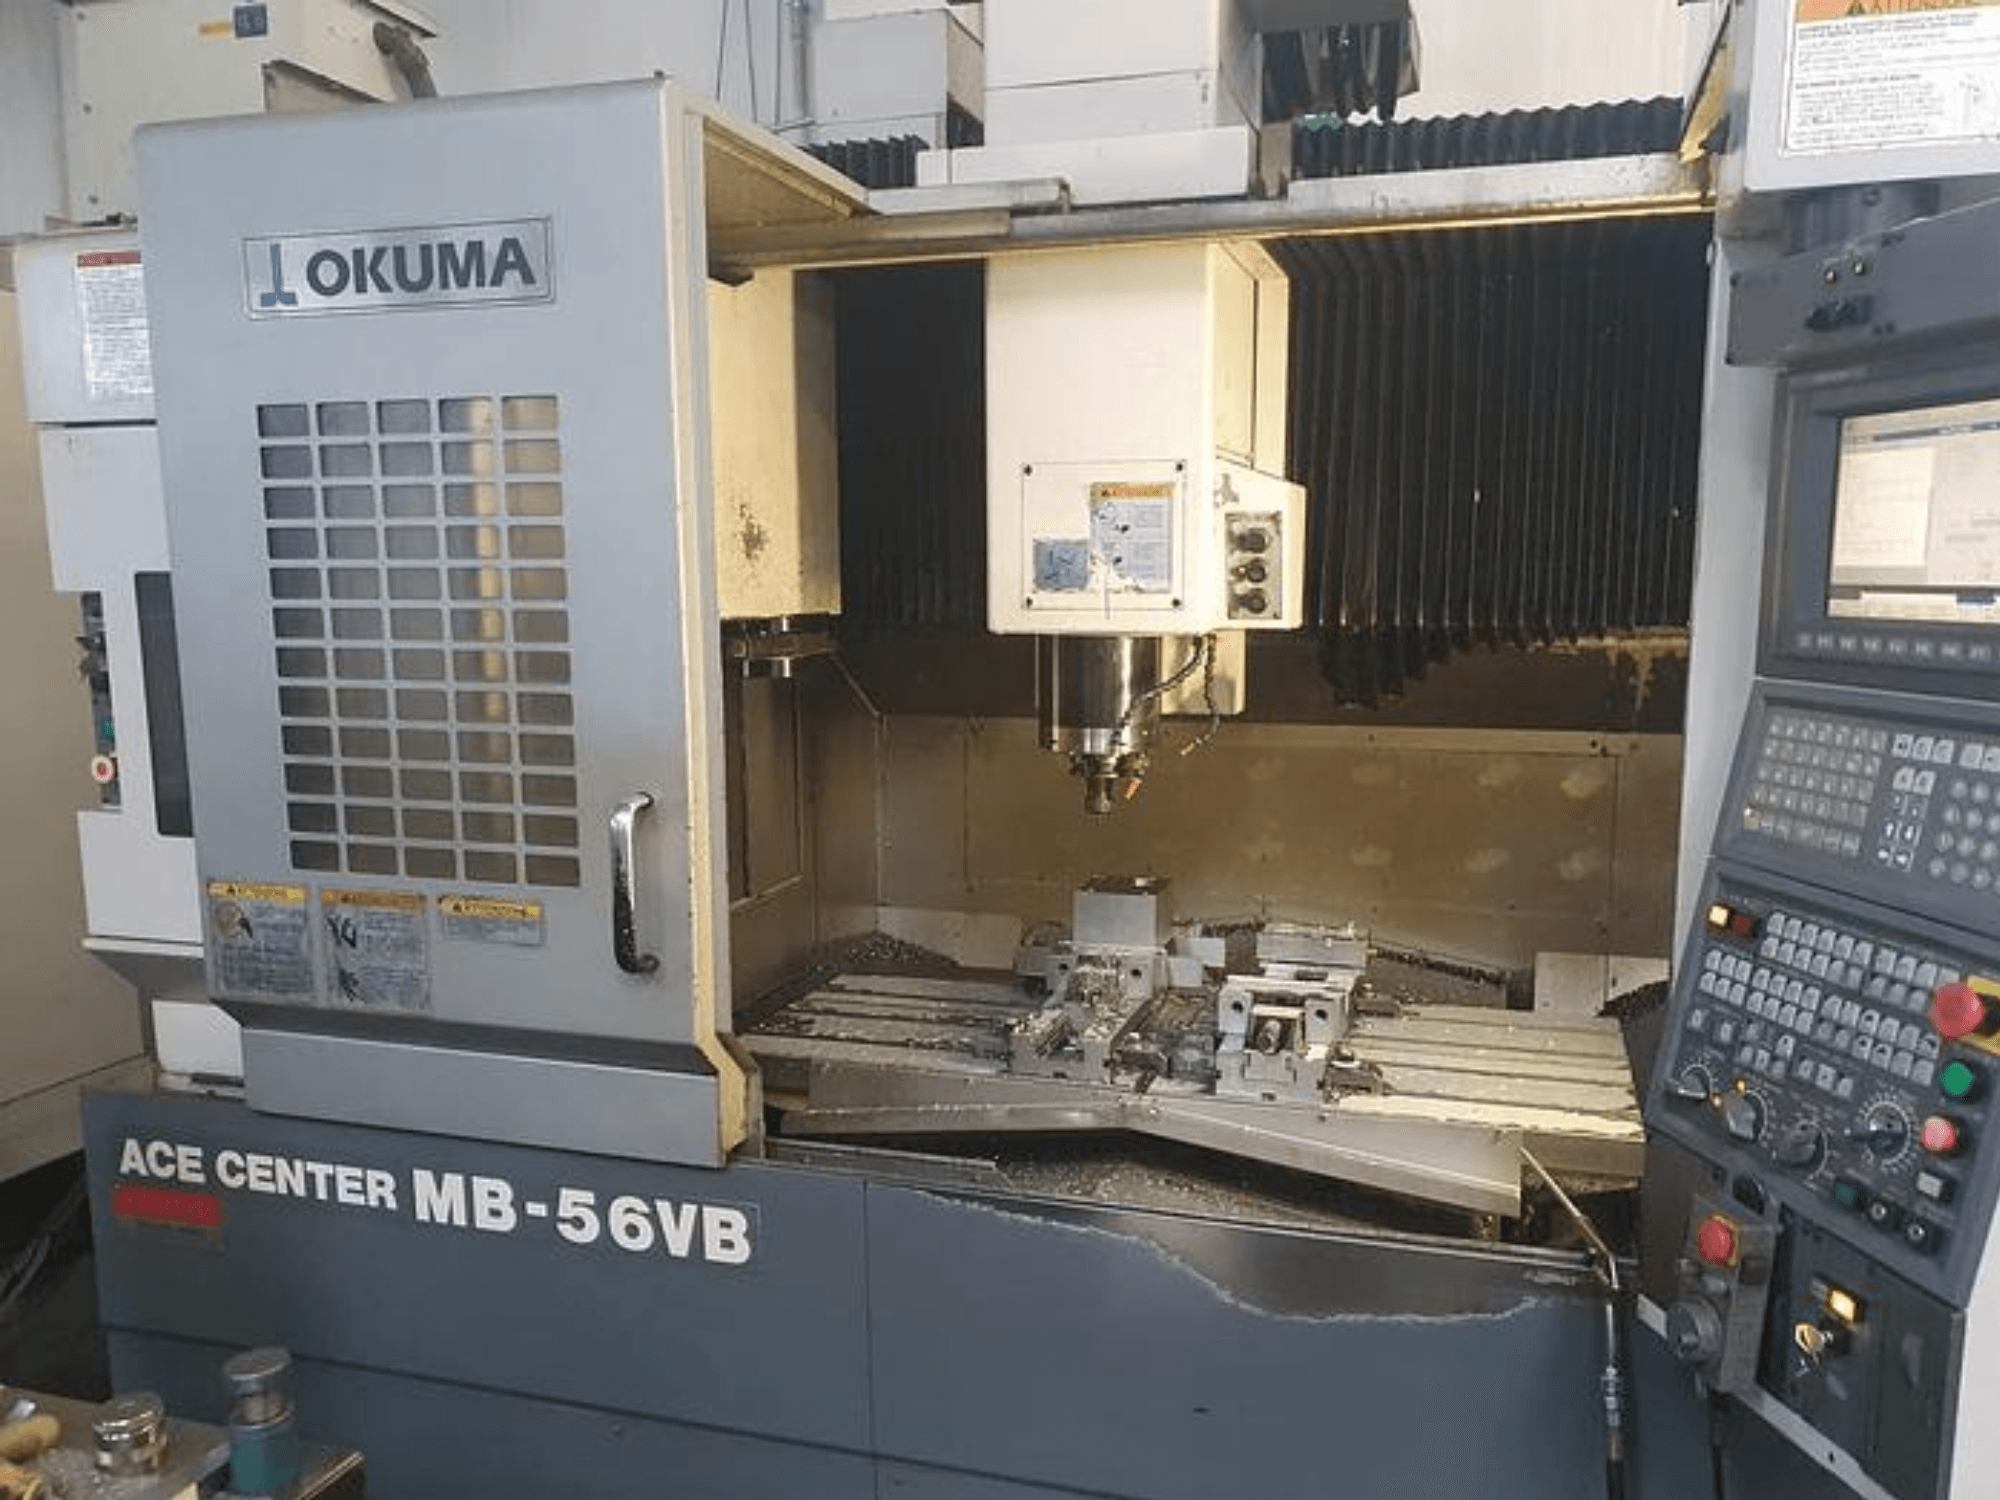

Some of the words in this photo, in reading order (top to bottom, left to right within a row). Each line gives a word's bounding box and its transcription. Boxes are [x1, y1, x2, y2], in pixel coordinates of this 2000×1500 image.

[306, 238, 536, 296] OKUMA
[119, 1139, 205, 1183] ACE
[215, 1151, 397, 1210] CENTER
[413, 1169, 751, 1264] MB-56VB
